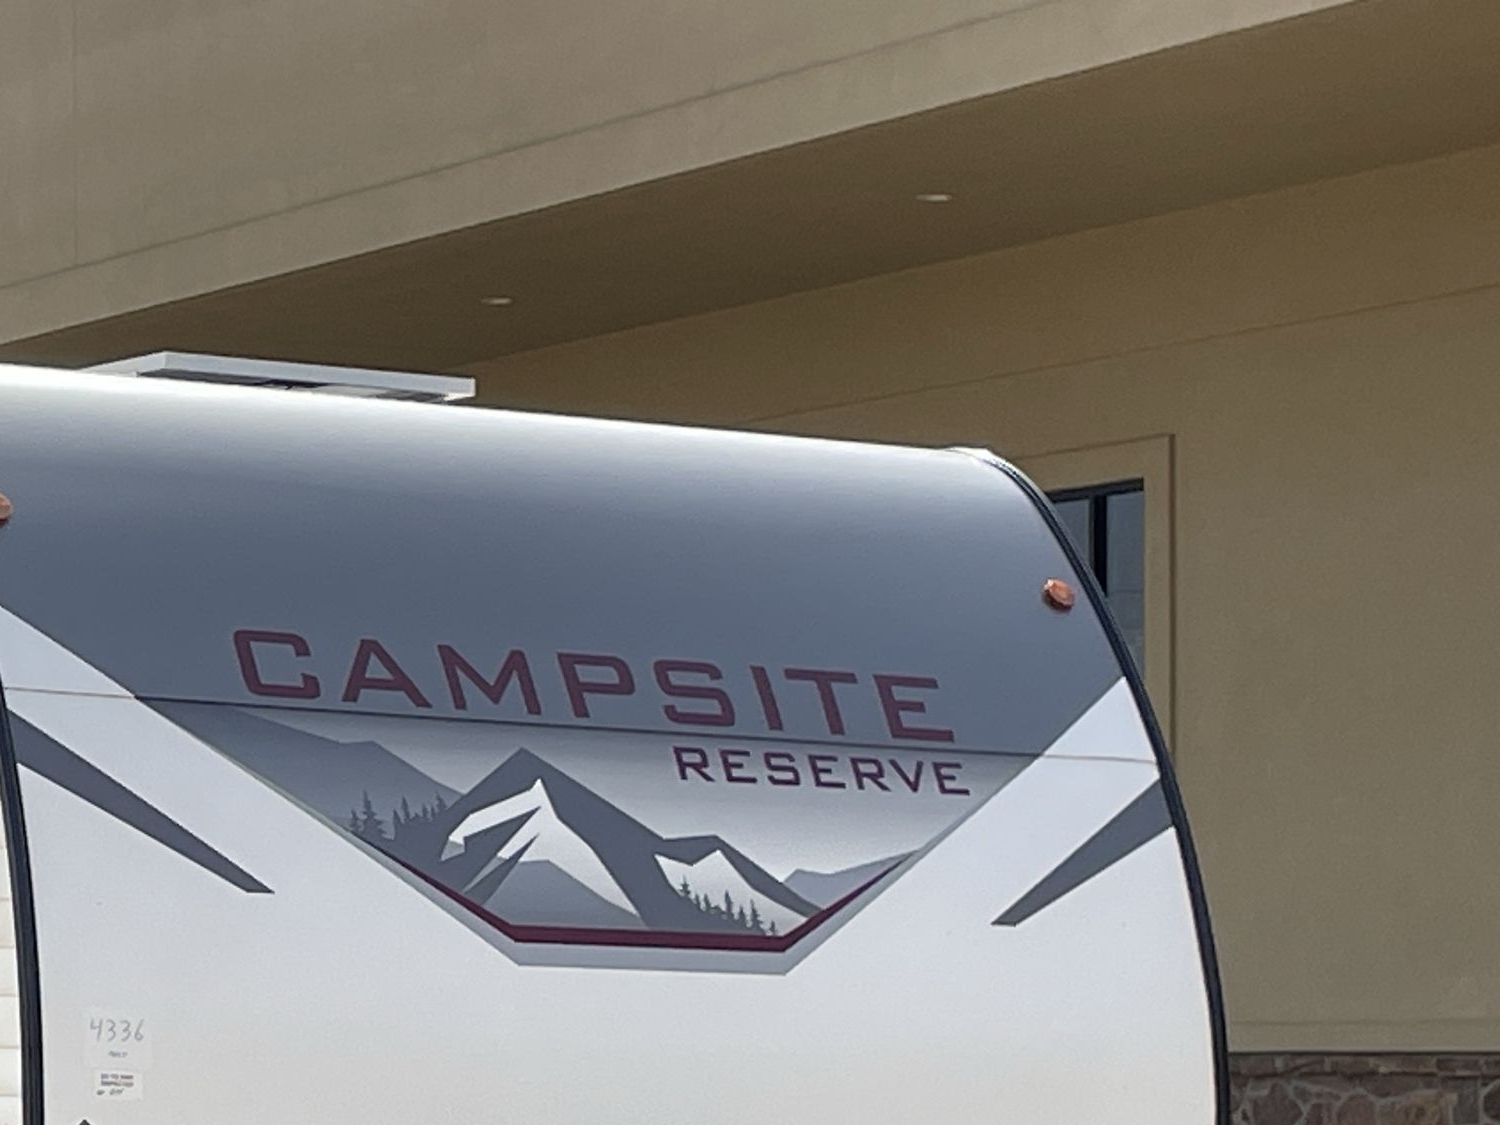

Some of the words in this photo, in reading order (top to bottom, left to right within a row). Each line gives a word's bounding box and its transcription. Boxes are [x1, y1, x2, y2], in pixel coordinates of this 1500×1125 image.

[232, 628, 955, 743] CAMPSITE
[673, 745, 970, 796] RESERVE
[90, 1017, 145, 1042] 4336
